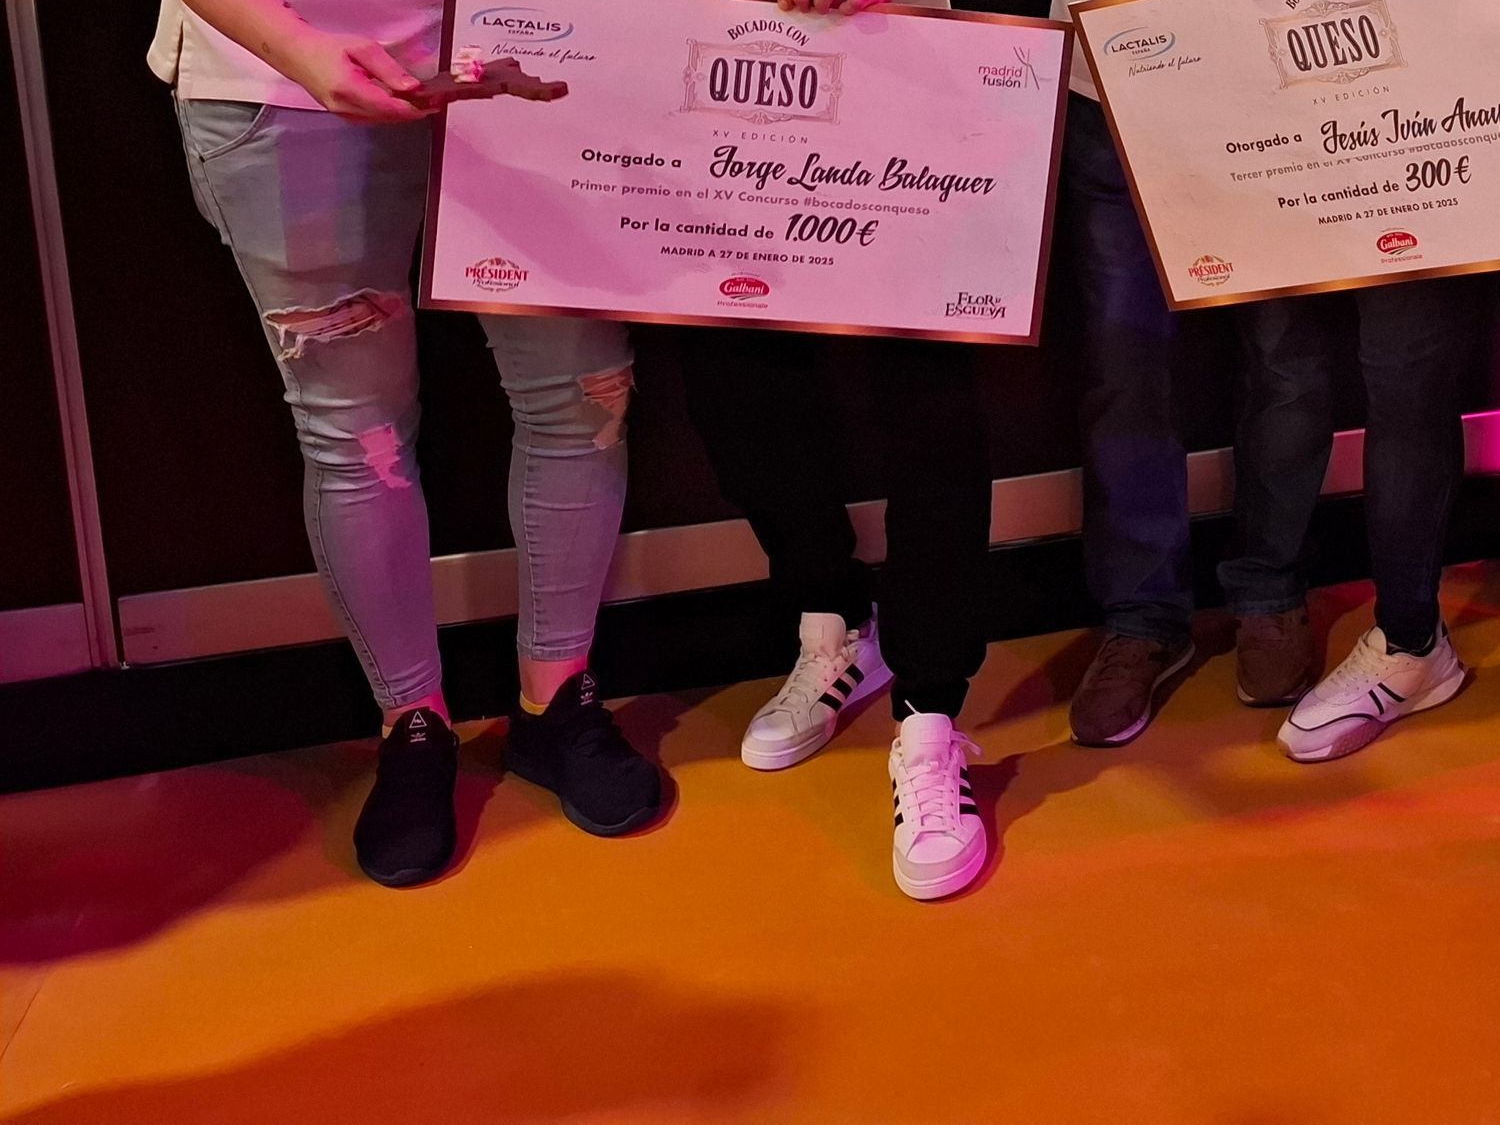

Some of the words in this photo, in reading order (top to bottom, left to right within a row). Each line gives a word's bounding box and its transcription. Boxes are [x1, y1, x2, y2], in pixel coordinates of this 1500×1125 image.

[482, 16, 562, 33] LACTALIS
[727, 19, 785, 41] BOCADOS
[786, 25, 811, 47] CON
[1111, 34, 1168, 53] LACTALIS
[1287, 15, 1380, 72] QUESO
[978, 65, 1023, 78] madrid
[982, 74, 1021, 89] fusión
[709, 57, 818, 110] QUESO
[1312, 97, 1326, 106] XV
[712, 129, 730, 139] XV
[741, 131, 809, 144] EDICIÓN
[1226, 133, 1289, 154] Otorgado
[1293, 133, 1302, 143] a
[1320, 120, 1380, 154] Jesús
[1381, 108, 1438, 144] Iván
[581, 148, 666, 169] Otorgado
[671, 157, 682, 169] a
[709, 145, 787, 191] Jorge
[787, 152, 875, 192] Landa
[878, 157, 997, 203] Balaguer
[1230, 169, 1262, 182] Tercer
[1266, 162, 1303, 179] premio
[1307, 161, 1320, 170] en
[1278, 196, 1301, 209] Por
[1303, 192, 1317, 205] la
[1321, 182, 1379, 203] cantidad
[1382, 179, 1400, 193] de
[1405, 158, 1451, 192] 300
[571, 179, 618, 193] Primer
[621, 183, 671, 197] premio
[676, 188, 692, 198] en
[696, 188, 709, 200] el
[713, 190, 734, 201] XV
[738, 191, 799, 207] Concurso
[803, 196, 931, 216] #bocadosconqueso
[1318, 213, 1353, 225] MADRID
[1355, 210, 1362, 220] A
[1364, 209, 1375, 219] 27
[1377, 207, 1389, 217] DE
[1390, 203, 1420, 217] ENERO
[1422, 201, 1434, 211] DE
[1436, 197, 1459, 208] 2025
[620, 216, 650, 230] Por
[654, 218, 670, 233] la
[676, 221, 749, 238] cantidad
[753, 225, 775, 240] de
[660, 245, 705, 257] MADRID
[708, 249, 716, 259] A
[719, 250, 733, 260] 27
[736, 251, 750, 260] DE
[752, 253, 789, 263] ENERO
[791, 254, 805, 264] DE
[808, 256, 835, 266] 2025
[465, 266, 529, 281] PRÉSIDENT
[958, 291, 995, 307] FLOR
[944, 302, 1007, 320] ESGUEVA
